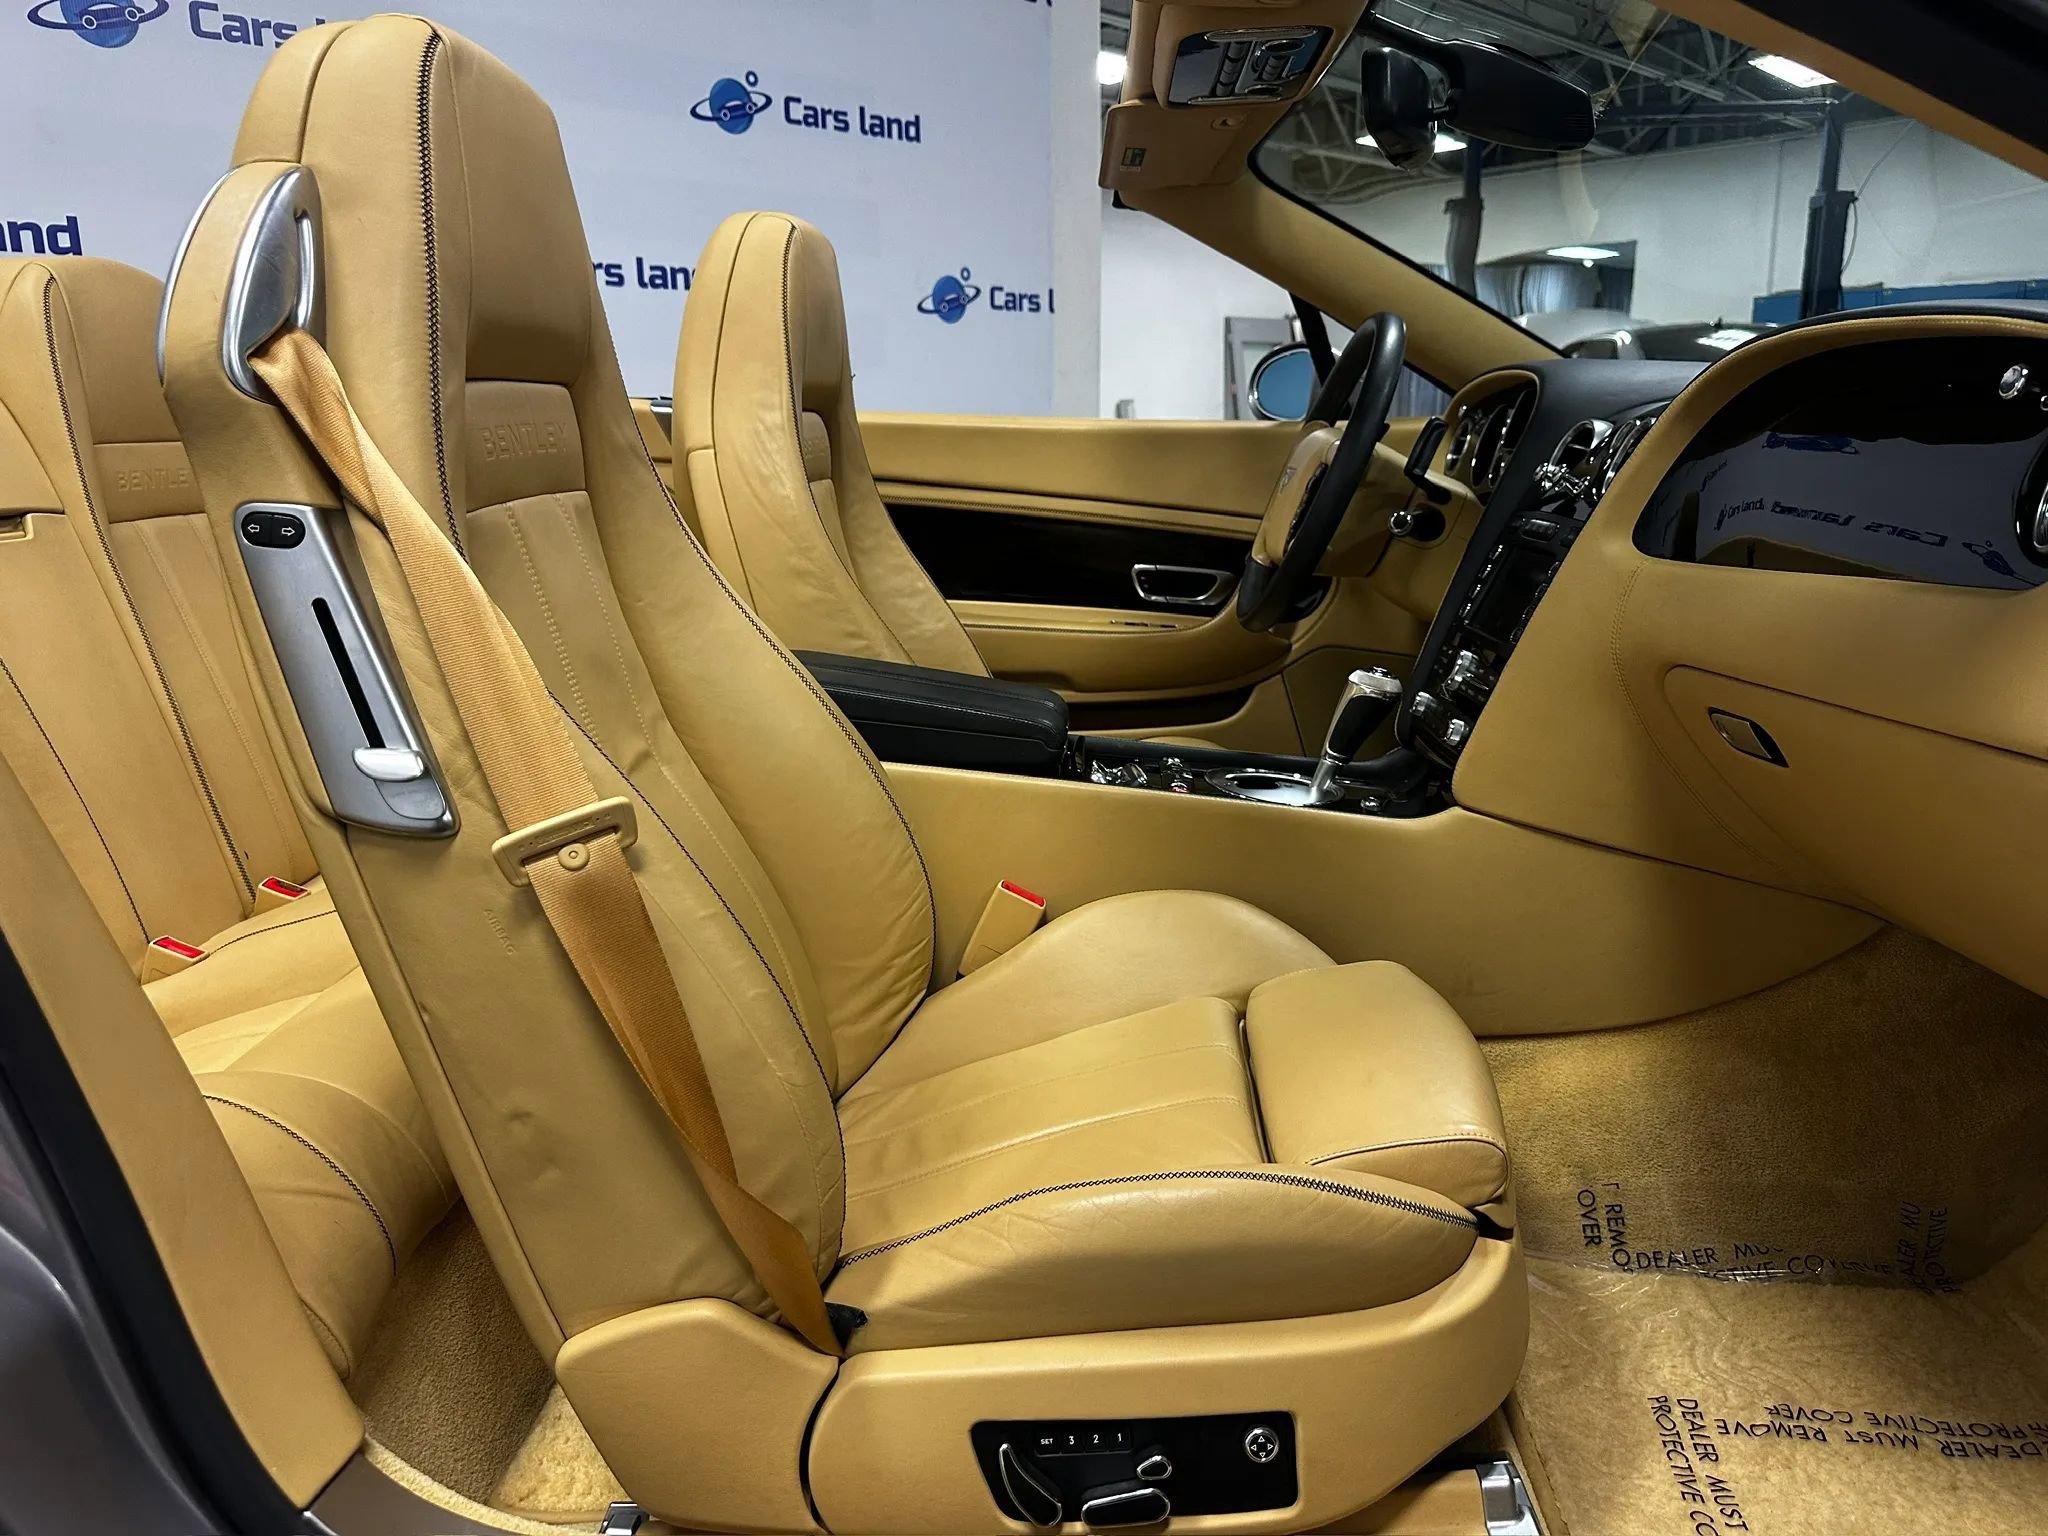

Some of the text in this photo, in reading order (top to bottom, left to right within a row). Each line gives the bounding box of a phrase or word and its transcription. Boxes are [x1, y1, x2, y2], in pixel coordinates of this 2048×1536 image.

[188, 0, 298, 48] Cars
[783, 96, 922, 144] Cars land
[636, 257, 696, 291] lan
[989, 286, 1041, 313] Cars
[479, 422, 569, 462] BENTLEY
[1577, 1189, 1602, 1248] OVER
[1605, 1203, 1634, 1274] REMO
[1763, 1403, 1853, 1425] COVER
[1864, 1410, 2028, 1441] PROTECTIVE
[1068, 1435, 1075, 1445] 3
[1093, 1433, 1100, 1444] 2
[1117, 1432, 1122, 1442] 1
[1647, 1395, 1706, 1504] PROTECTIVE
[1714, 1418, 2042, 1460] DEALER MUST REMOVE
[1677, 1398, 1749, 1531] DEALER MUST
